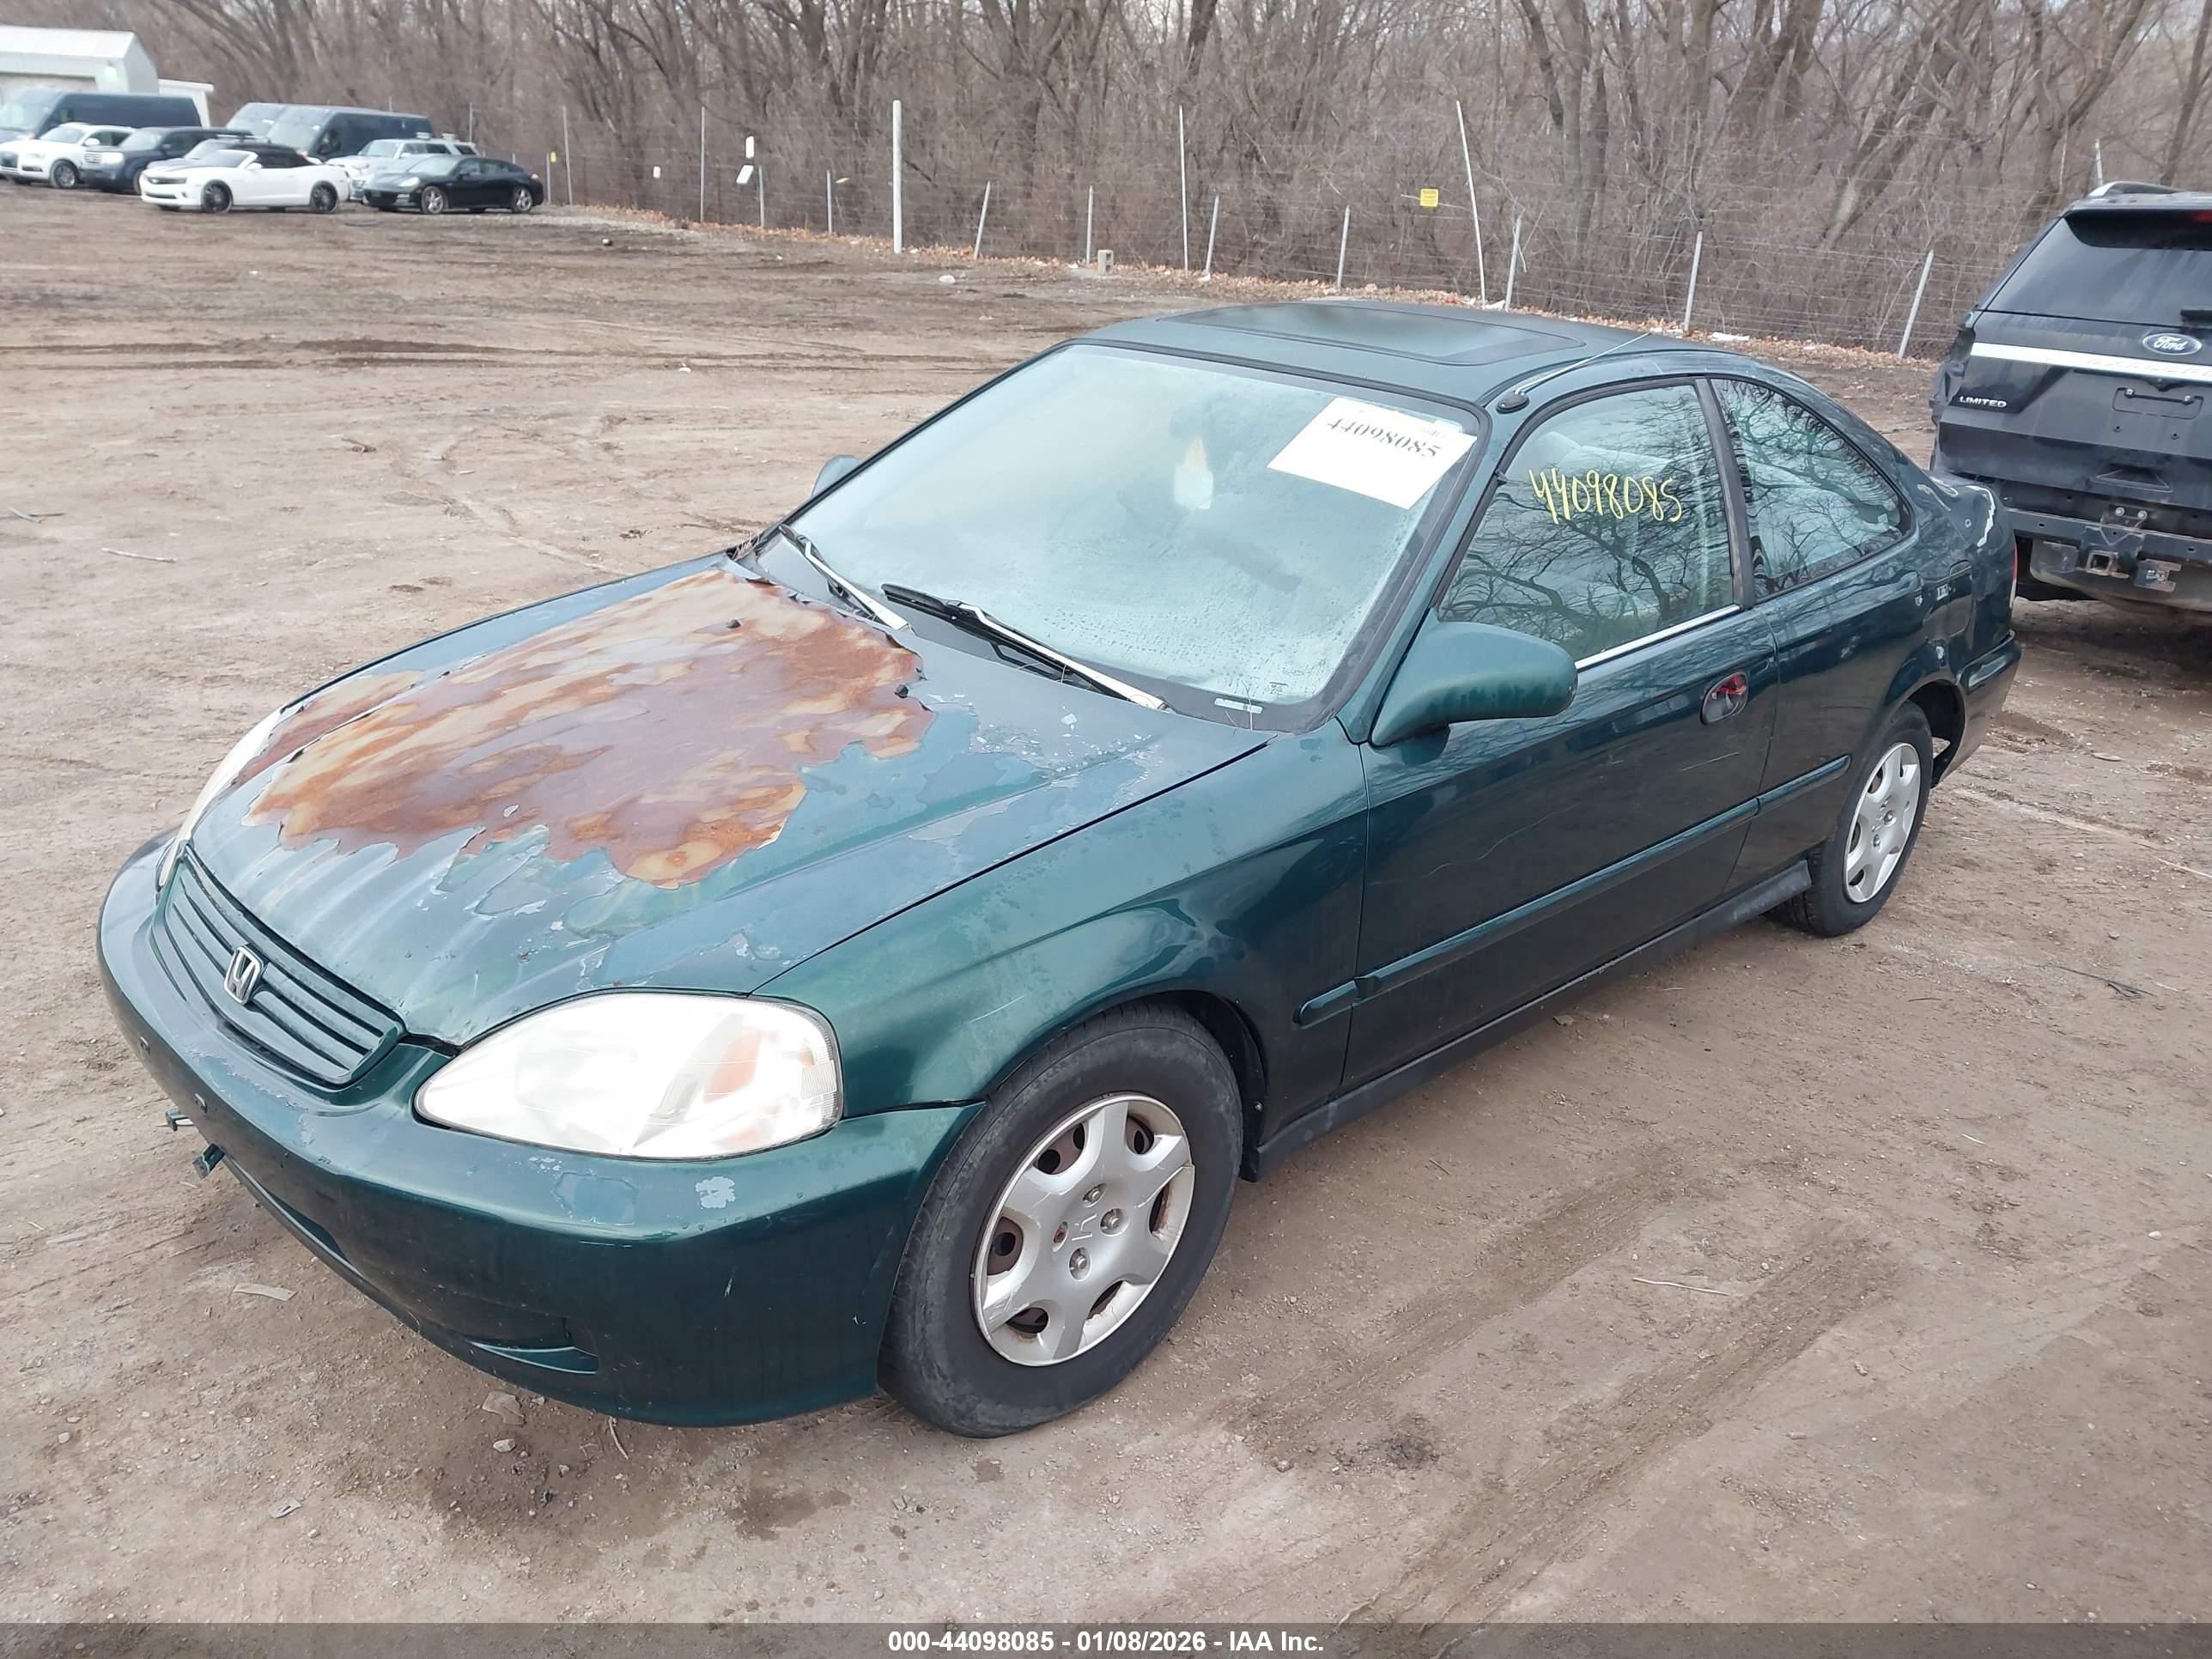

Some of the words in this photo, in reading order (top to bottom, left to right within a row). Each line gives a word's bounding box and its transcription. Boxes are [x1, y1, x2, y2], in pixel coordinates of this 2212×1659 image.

[2154, 336, 2189, 351] Ford
[1960, 396, 2008, 408] LIMITED
[1327, 417, 1443, 458] 44098085
[1528, 467, 1682, 525] 44098085
